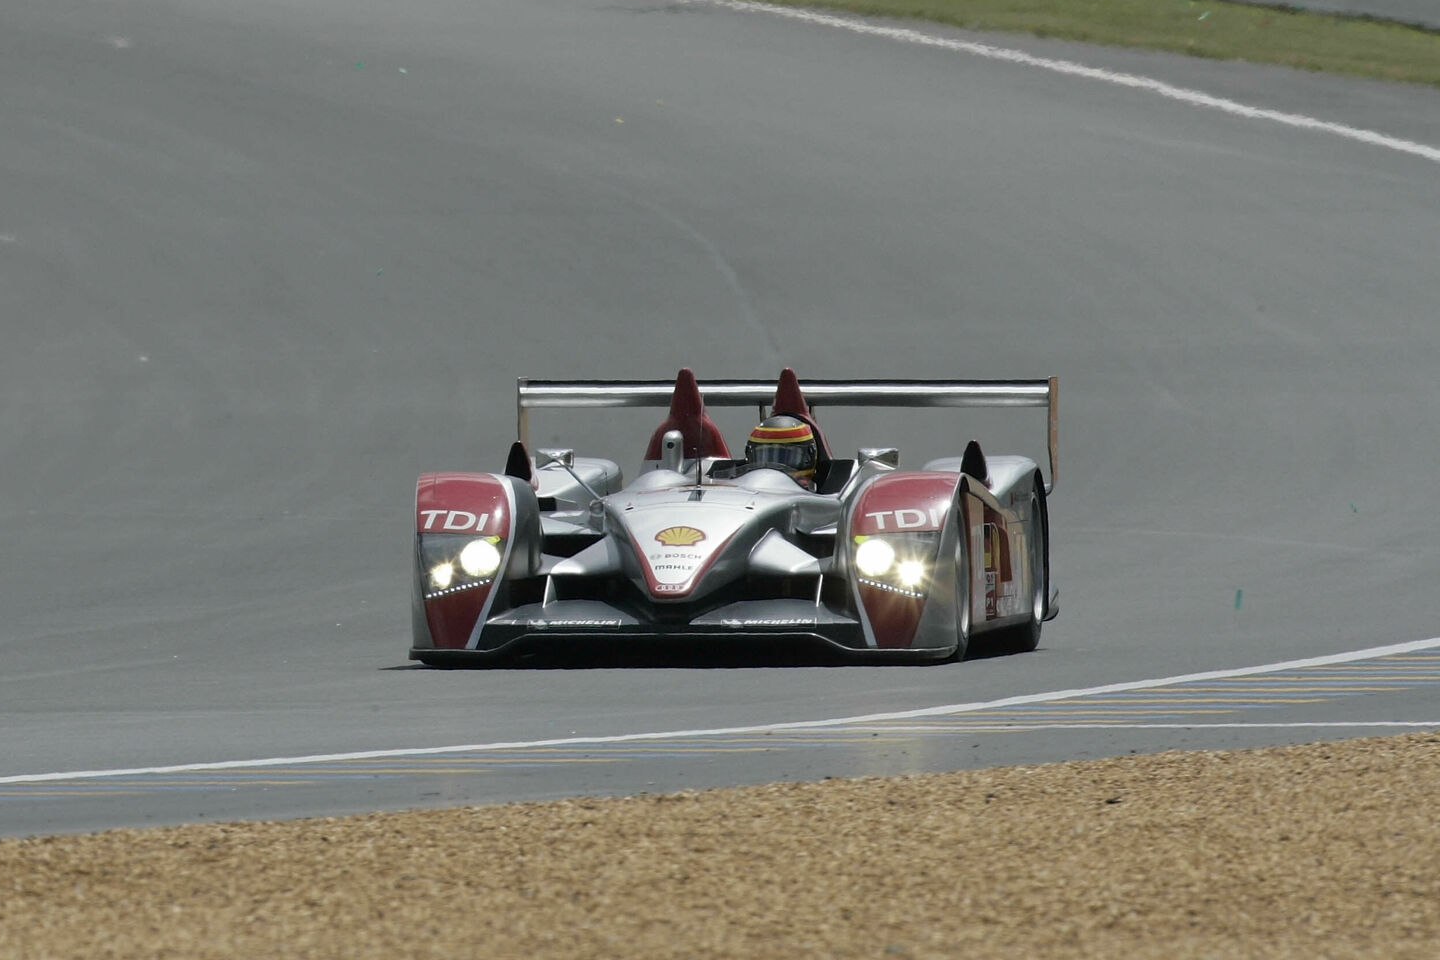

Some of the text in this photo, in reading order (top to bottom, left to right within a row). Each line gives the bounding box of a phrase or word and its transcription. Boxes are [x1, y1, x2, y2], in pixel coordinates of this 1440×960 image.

[420, 510, 490, 532] TDI
[865, 508, 940, 530] TDI
[664, 552, 702, 560] BOSCH
[744, 618, 813, 626] MICHELIN
